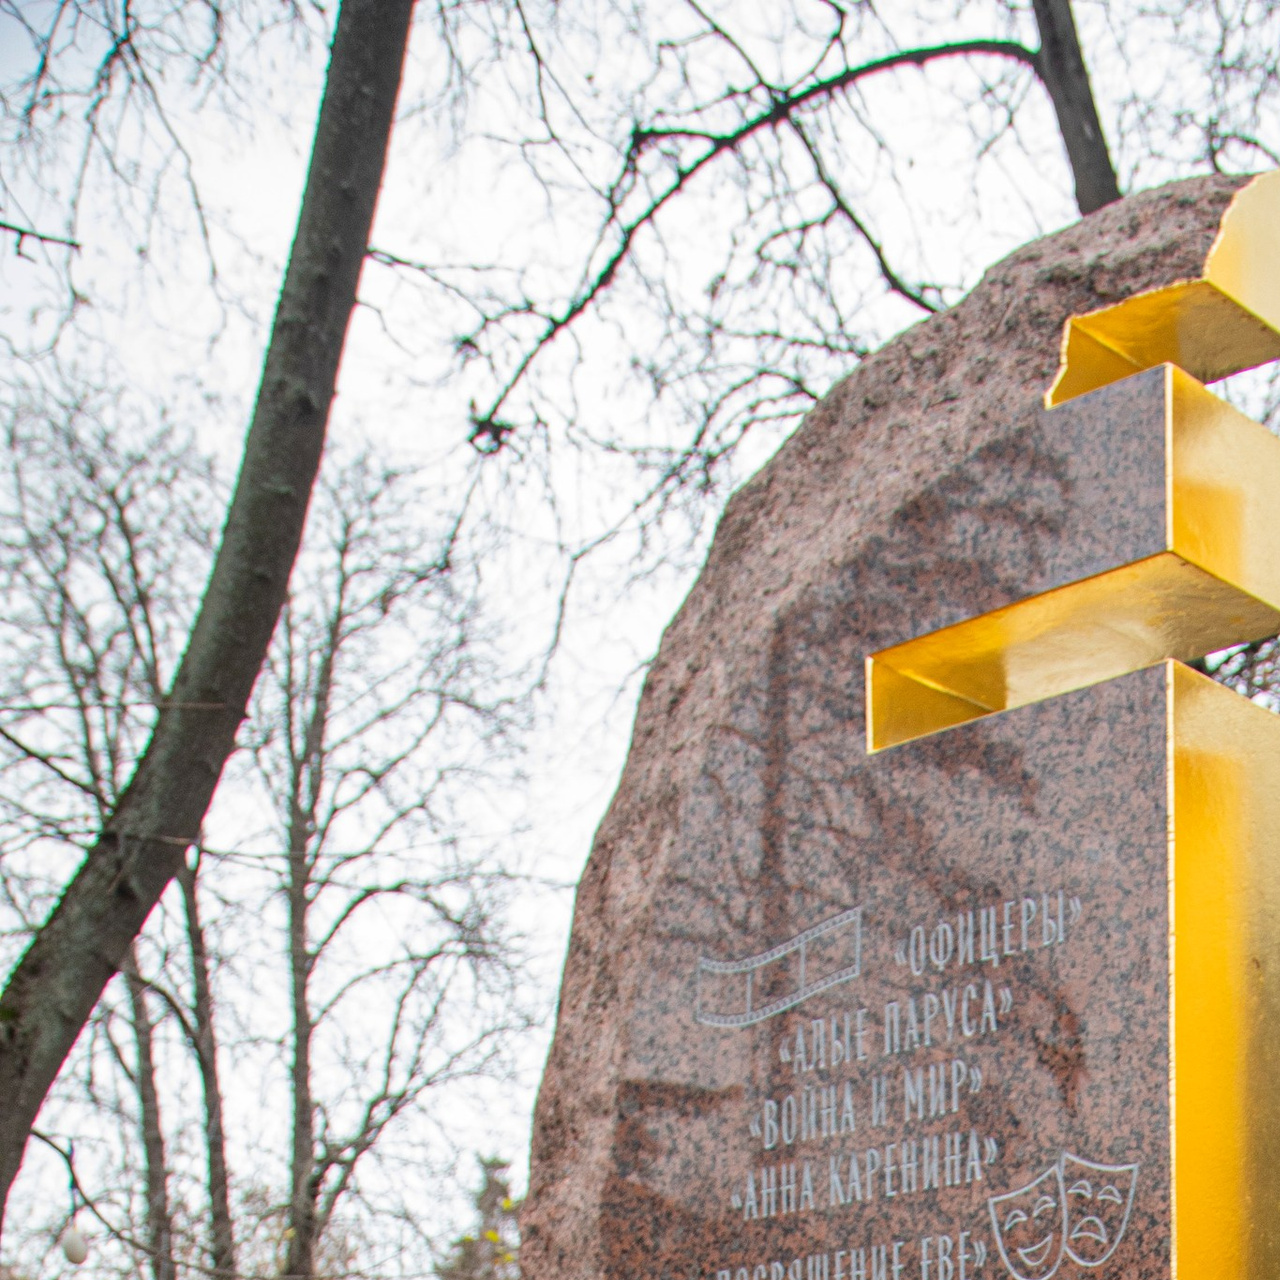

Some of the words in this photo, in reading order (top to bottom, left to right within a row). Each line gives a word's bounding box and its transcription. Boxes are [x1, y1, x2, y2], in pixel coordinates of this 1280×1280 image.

[894, 890, 1084, 977] «ОФИЦЕРЫ»
[779, 1008, 869, 1075] «АЛЫЕ
[883, 982, 1014, 1057] ПАРУСА»
[749, 1079, 857, 1150] «ВОЙНА
[870, 1077, 889, 1125] И
[903, 1058, 983, 1124] МИР»
[730, 1159, 816, 1221] «АННА
[828, 1130, 999, 1206] КАРЕНИНА»
